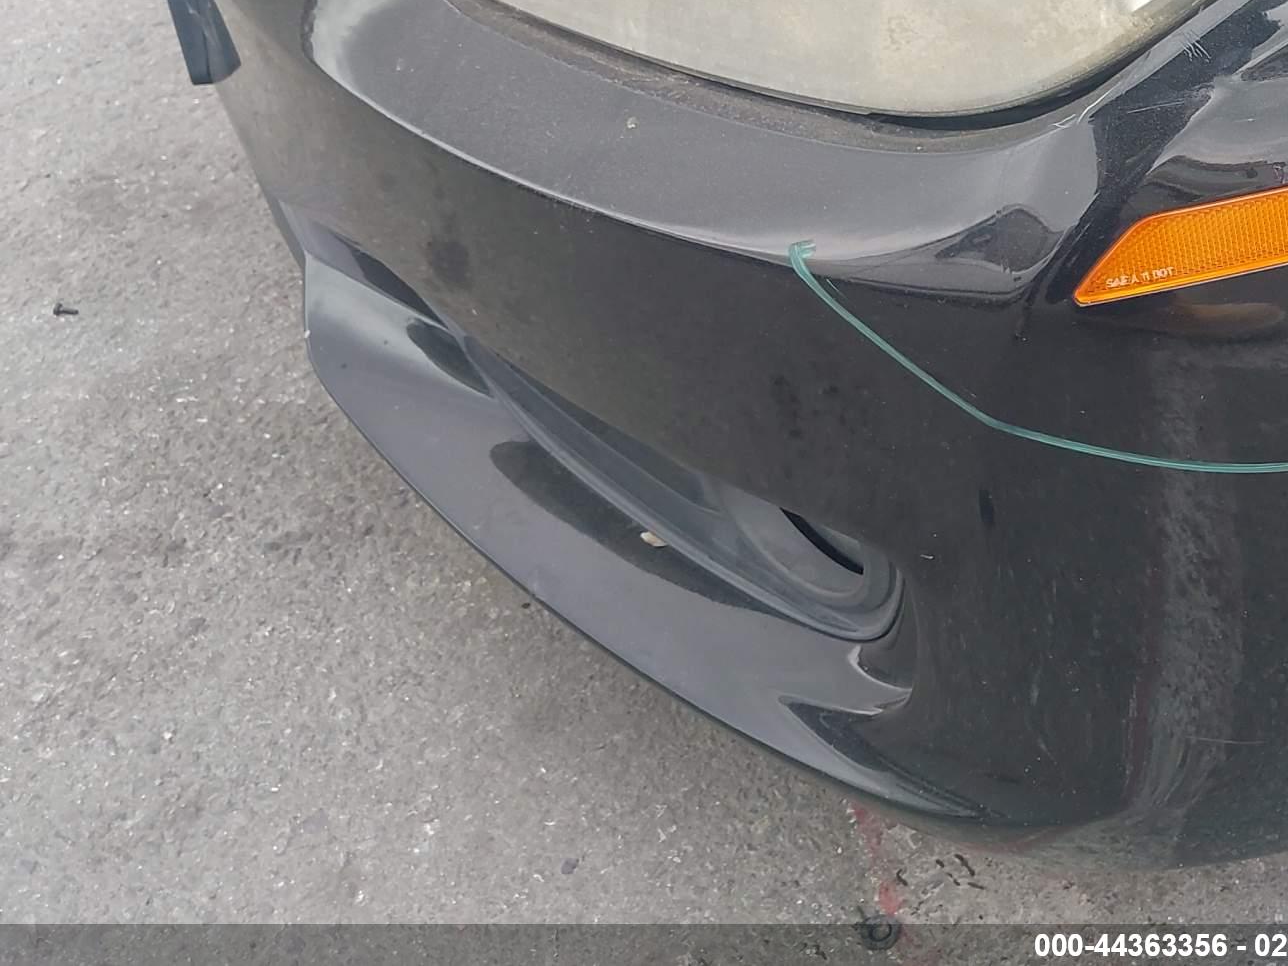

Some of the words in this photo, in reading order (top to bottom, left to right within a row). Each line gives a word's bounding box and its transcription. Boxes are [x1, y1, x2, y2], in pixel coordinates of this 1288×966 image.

[1106, 275, 1130, 288] SAE
[1131, 274, 1140, 284] A
[1152, 266, 1174, 279] DOT
